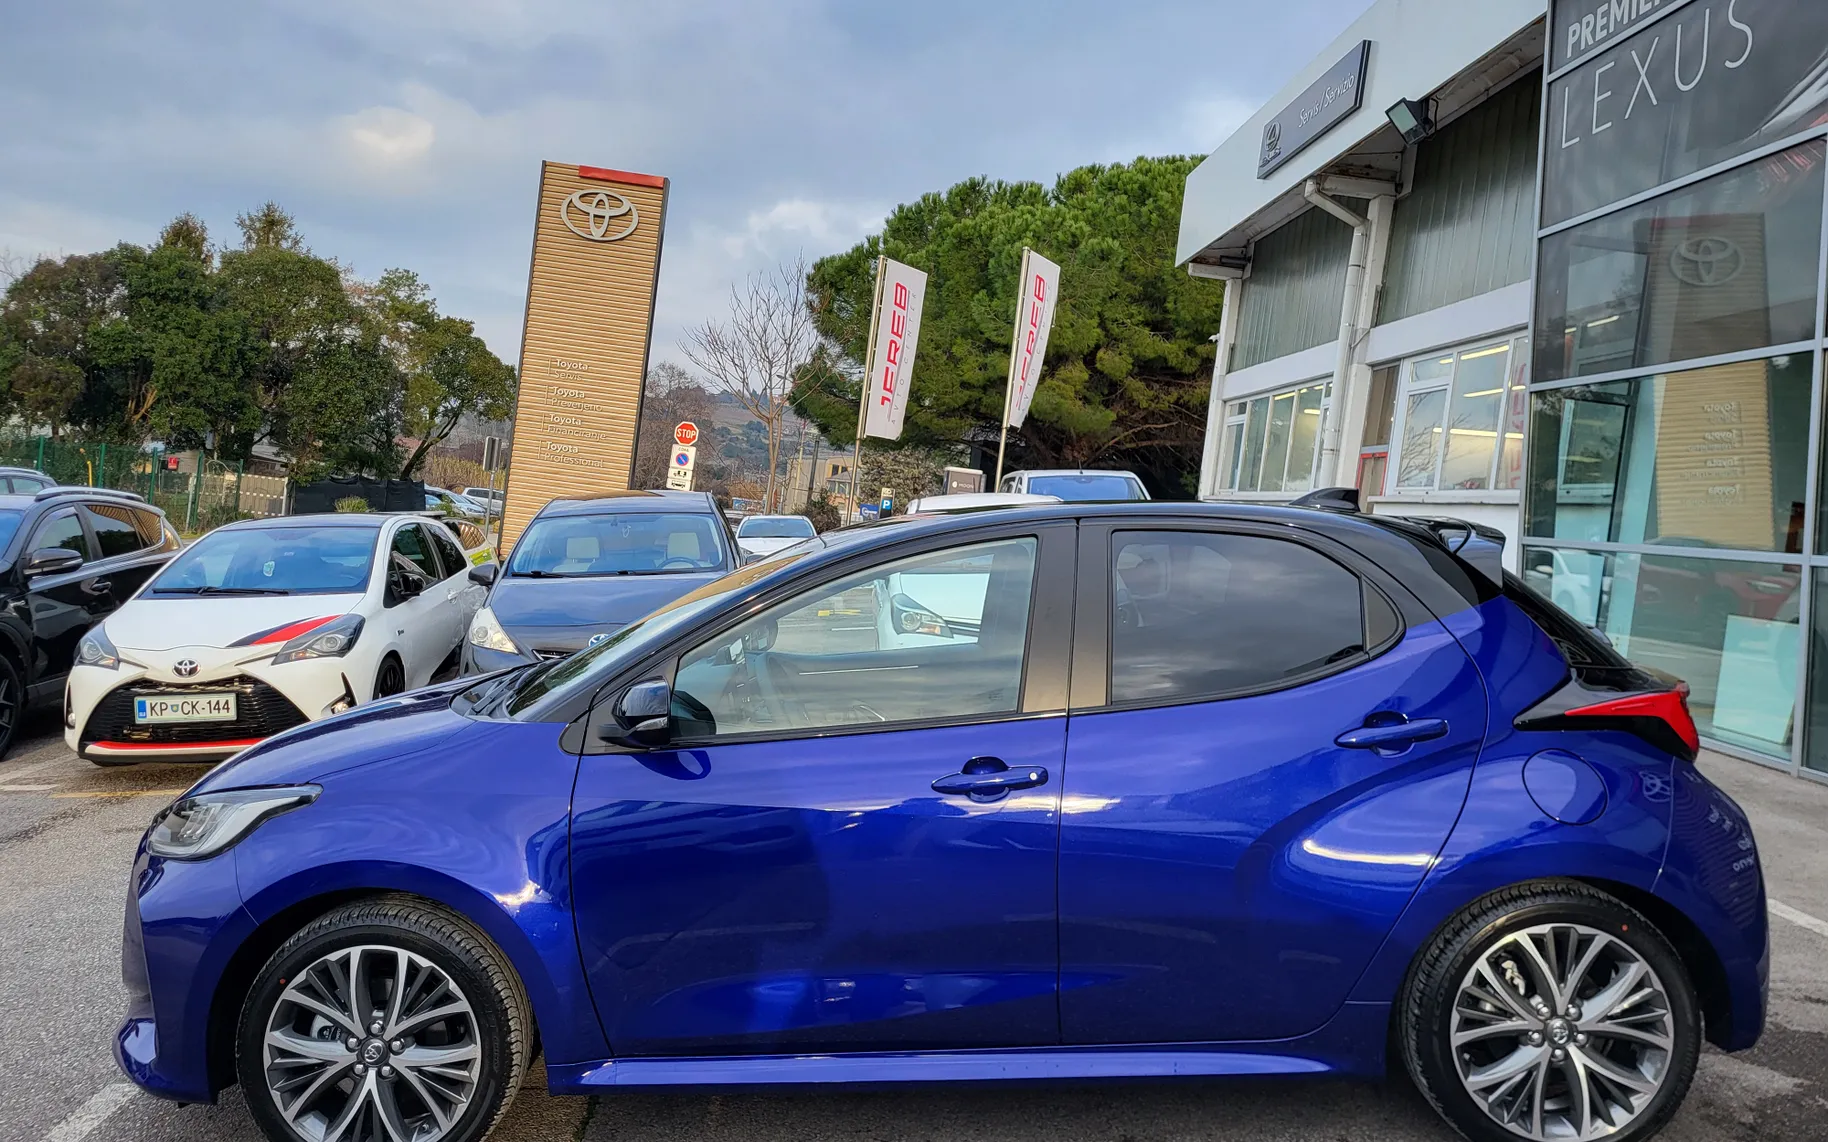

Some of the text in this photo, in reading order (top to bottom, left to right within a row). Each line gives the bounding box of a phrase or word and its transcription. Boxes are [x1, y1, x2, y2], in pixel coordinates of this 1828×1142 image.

[1567, 0, 1660, 58] PREMI
[1562, 0, 1753, 148] LEXUS
[880, 282, 908, 406] JEREB
[556, 359, 588, 370] Toyota
[554, 370, 582, 381] Servis
[552, 386, 585, 398] Toyota
[551, 398, 603, 412] Preverjeno
[549, 413, 582, 425] Toyota
[547, 424, 607, 441] Financiranje
[677, 429, 697, 439] STOP
[546, 441, 579, 453] Toyota
[544, 452, 603, 468] Professional
[883, 500, 891, 509] P
[150, 699, 230, 716] KP CK-144
